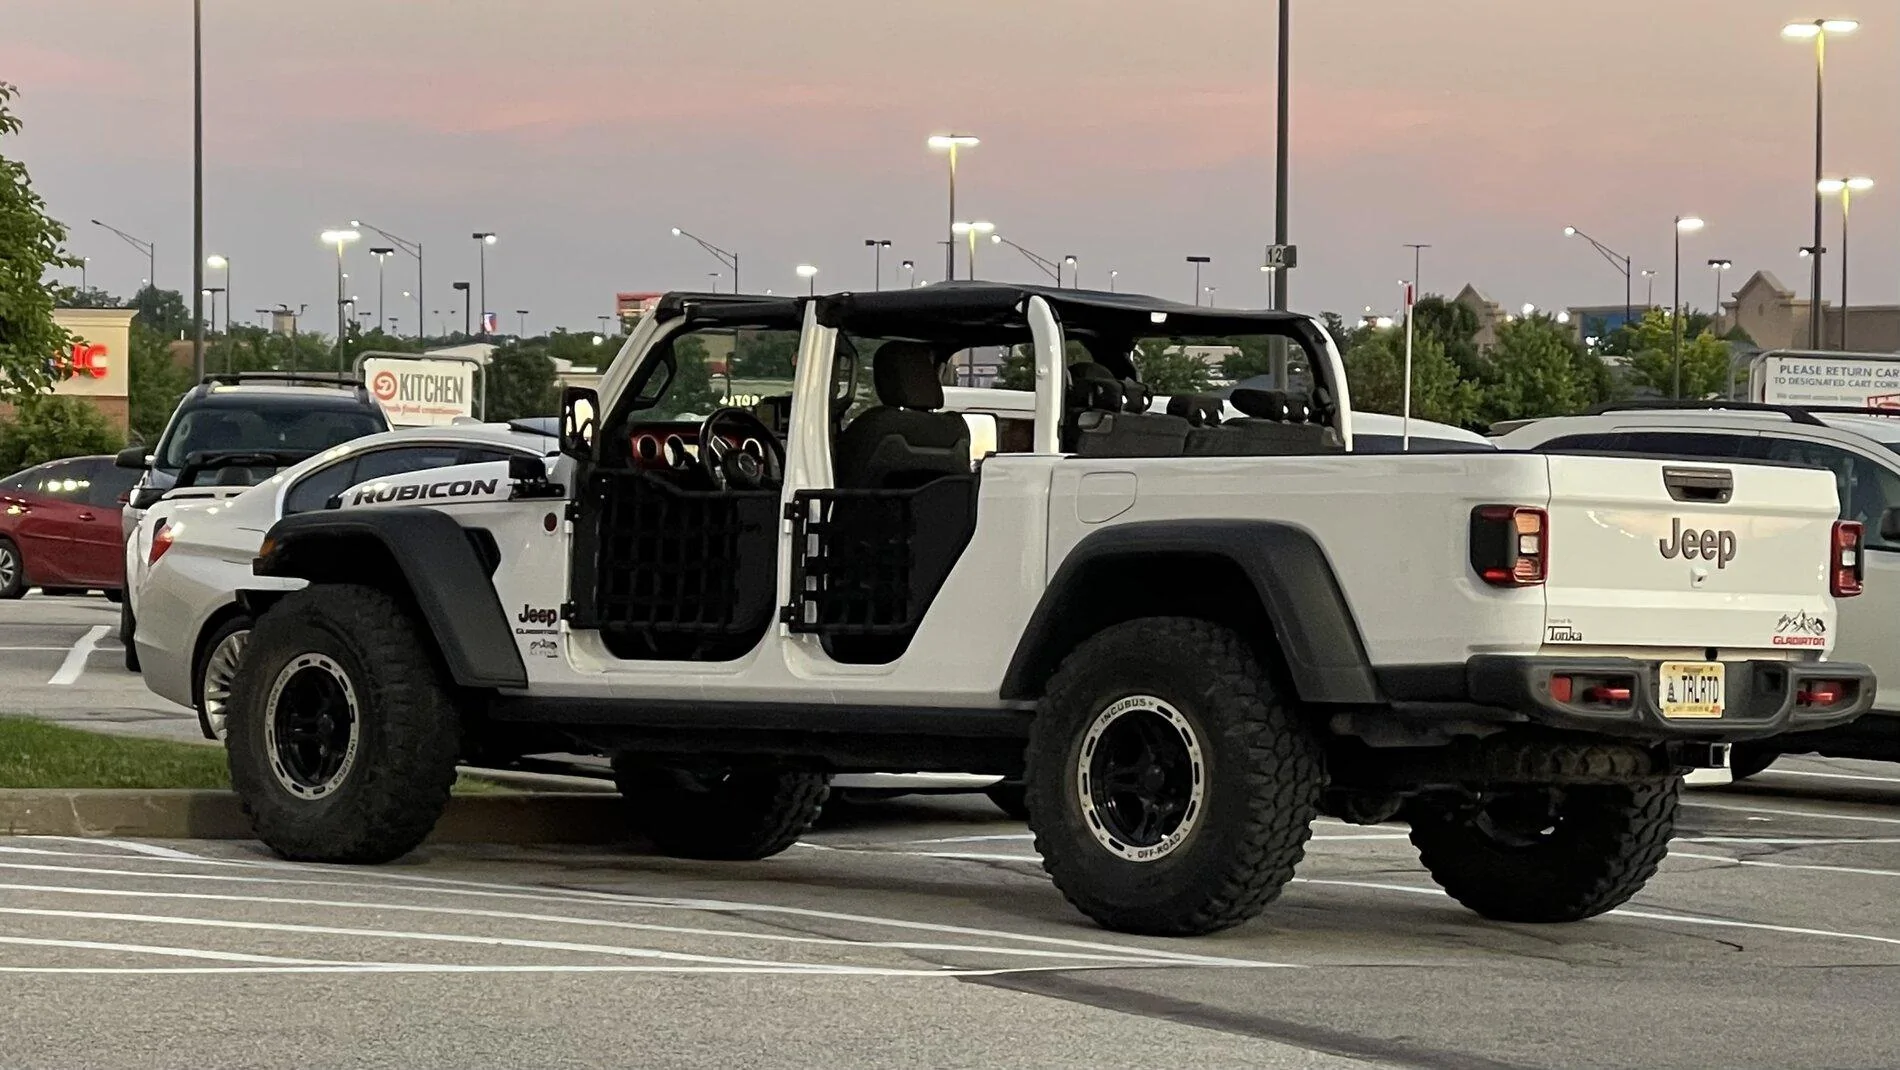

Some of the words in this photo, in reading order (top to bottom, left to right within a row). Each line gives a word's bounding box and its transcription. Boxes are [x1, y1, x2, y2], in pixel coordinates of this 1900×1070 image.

[1268, 248, 1282, 263] 12
[1780, 364, 1820, 375] PLEASE
[1826, 366, 1872, 377] RETURN
[400, 373, 463, 404] KITCHEN
[1774, 377, 1785, 385] TO
[1788, 377, 1845, 387] DESIGNATED
[1848, 379, 1871, 387] CART
[353, 478, 499, 506] RUBICON
[1659, 517, 1737, 569] Jeep
[518, 603, 557, 628] Jeep
[1547, 626, 1582, 641] Tonka
[1773, 635, 1825, 646] GLADIATOR
[1100, 698, 1146, 724] INCUBUS
